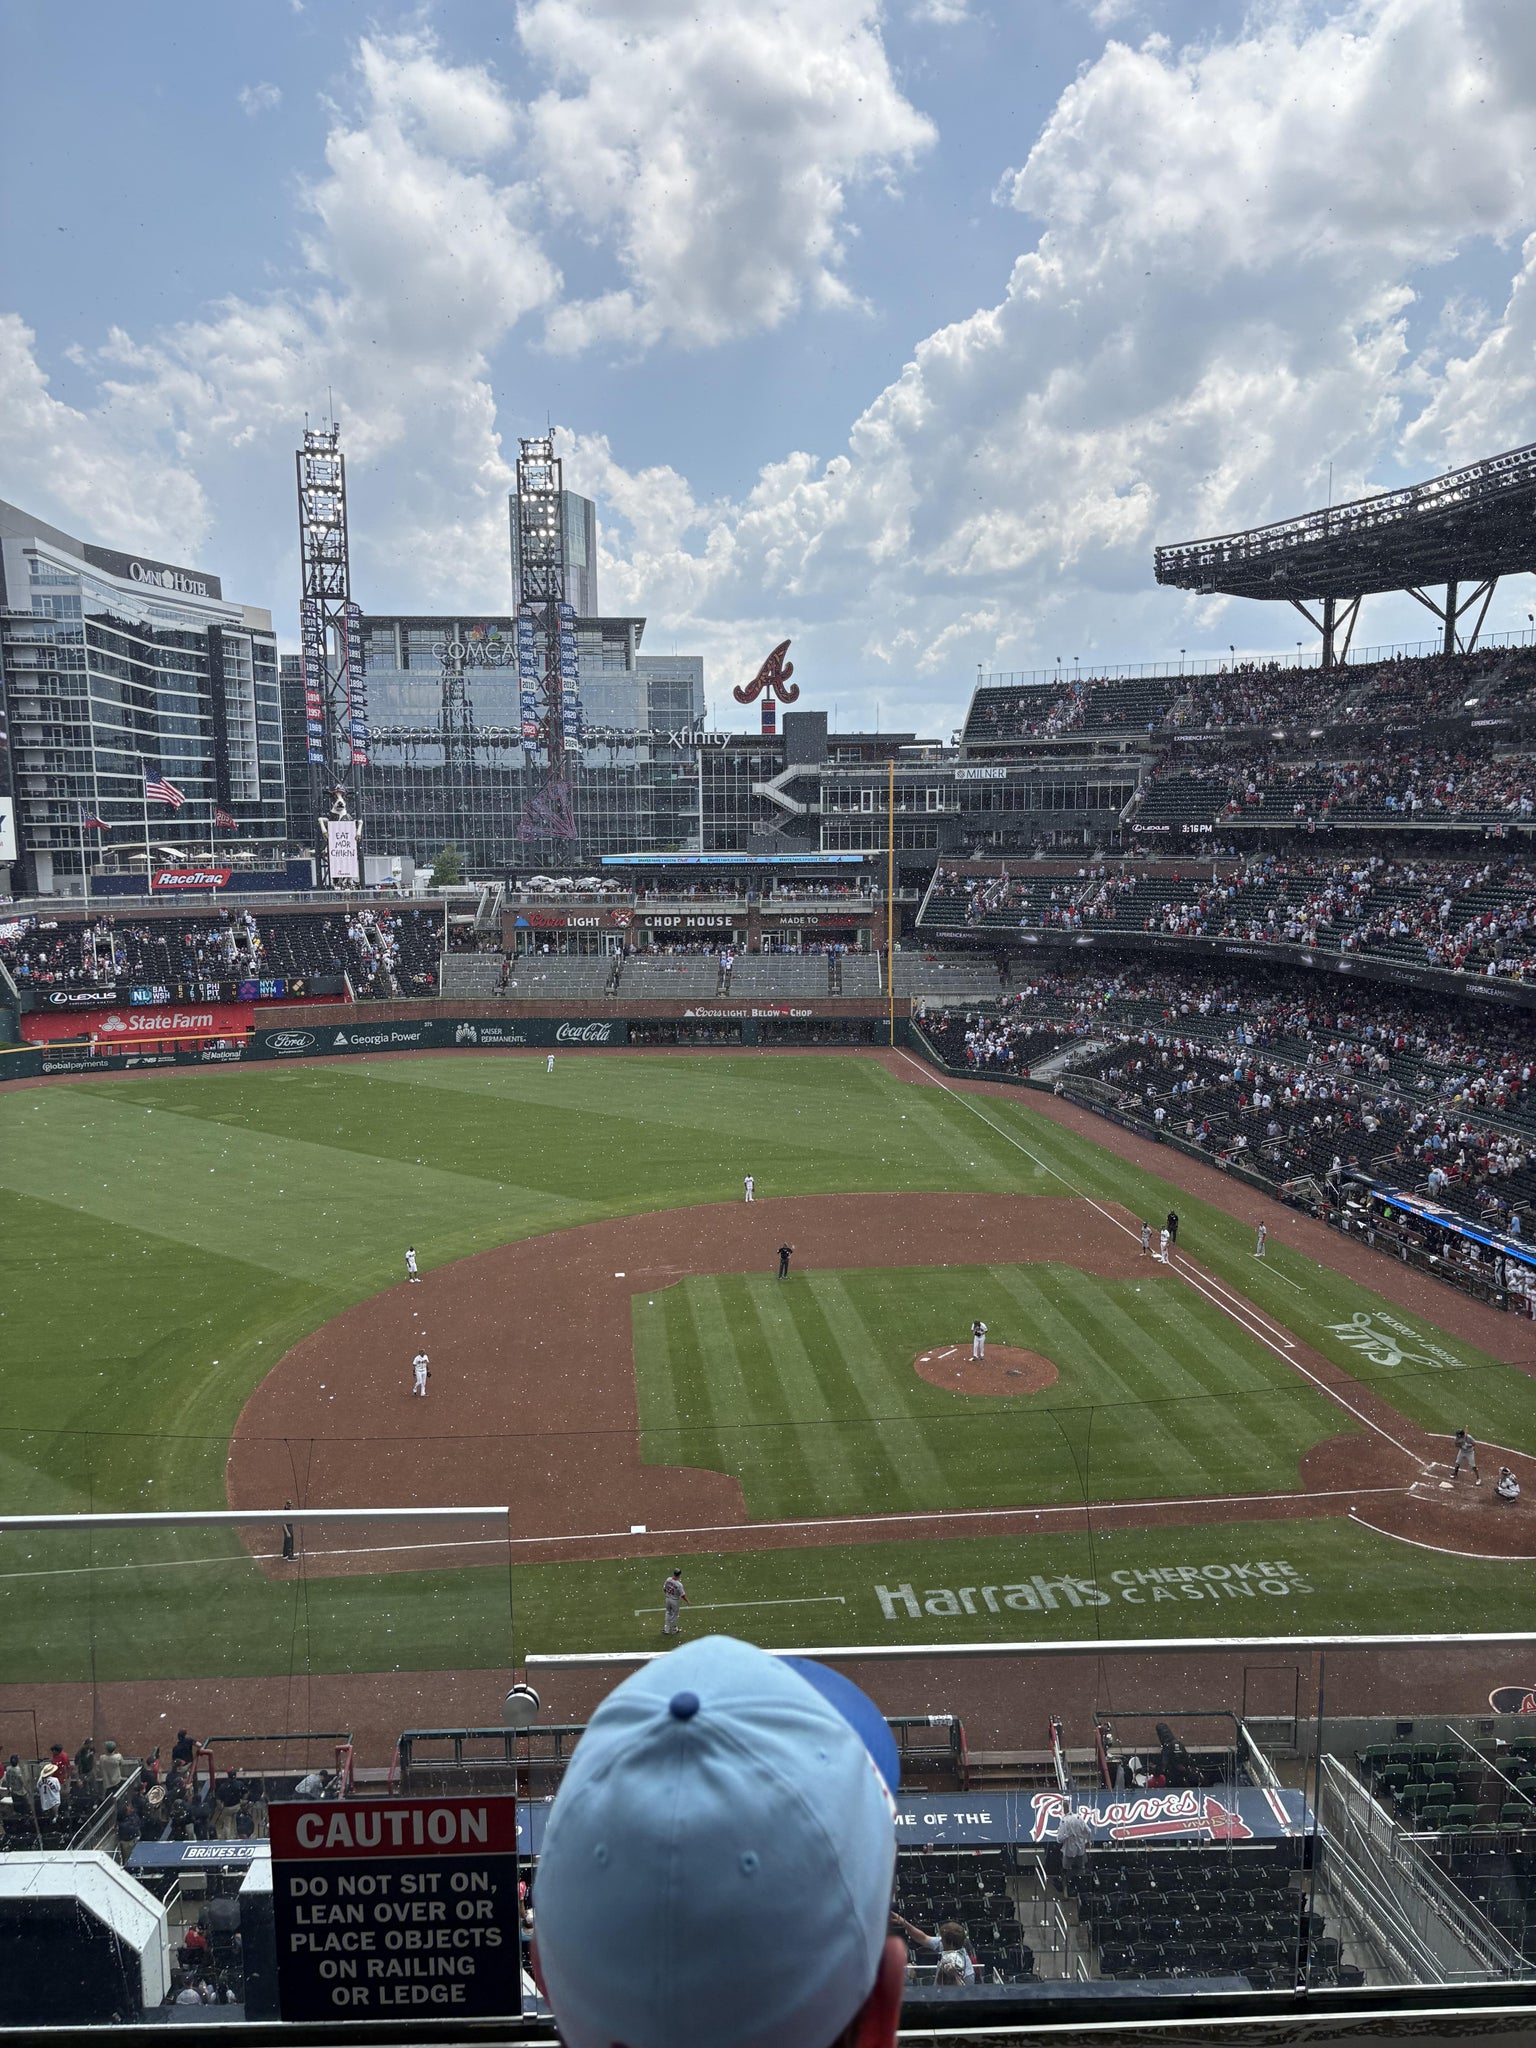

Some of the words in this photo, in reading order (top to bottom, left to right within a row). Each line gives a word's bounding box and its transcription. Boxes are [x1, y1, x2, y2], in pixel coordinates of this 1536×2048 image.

[130, 562, 162, 587] OMNI
[174, 572, 209, 597] HOTEL
[432, 642, 516, 660] COMCA
[563, 681, 575, 689] 2012
[522, 696, 535, 704] 2013
[308, 708, 321, 716] 1957
[523, 711, 536, 719] 2019
[564, 710, 576, 719] 2020
[564, 725, 577, 733] 2022
[668, 726, 732, 749] xfinity
[967, 769, 1004, 778] MILNER
[336, 832, 349, 840] EAT
[335, 840, 351, 848] MOR
[158, 872, 223, 884] RaceTrac
[567, 918, 600, 926] LIGHT
[645, 917, 681, 926] CHOP
[687, 916, 732, 926] HOUSE
[68, 992, 117, 1001] LEXUS
[133, 992, 150, 1001] NL
[695, 1007, 722, 1017] Coors
[790, 1009, 812, 1017] CHOP
[129, 1015, 171, 1030] State
[173, 1014, 212, 1029] Farm
[556, 1022, 613, 1042] Coca-Cola
[274, 1033, 310, 1047] Ford
[351, 1034, 389, 1045] Georgia
[391, 1032, 421, 1042] Power
[481, 1035, 525, 1043] PERMANENTE
[211, 1050, 241, 1058] National
[1111, 1560, 1299, 1586] CHEROKEE
[1122, 1578, 1316, 1604] CASINOS
[894, 1815, 917, 1825] ME
[924, 1814, 948, 1824] OF
[954, 1813, 993, 1824] THE
[296, 1808, 488, 1849] CAUTION
[187, 1847, 255, 1857] BRAVES.CO
[290, 1876, 328, 1896] DO
[338, 1875, 392, 1895] NOT
[400, 1873, 442, 1894] SIT
[450, 1872, 498, 1894] ON,
[296, 1904, 364, 1925] LEAN
[373, 1902, 446, 1922] OVER
[456, 1900, 494, 1920] OR
[291, 1932, 376, 1952] PLACE
[384, 1928, 503, 1949] OBJECTS
[319, 1959, 357, 1979] ON
[367, 1956, 475, 1978] RAILING
[332, 1987, 369, 2006] OR
[379, 1984, 466, 2005] LEDGE
